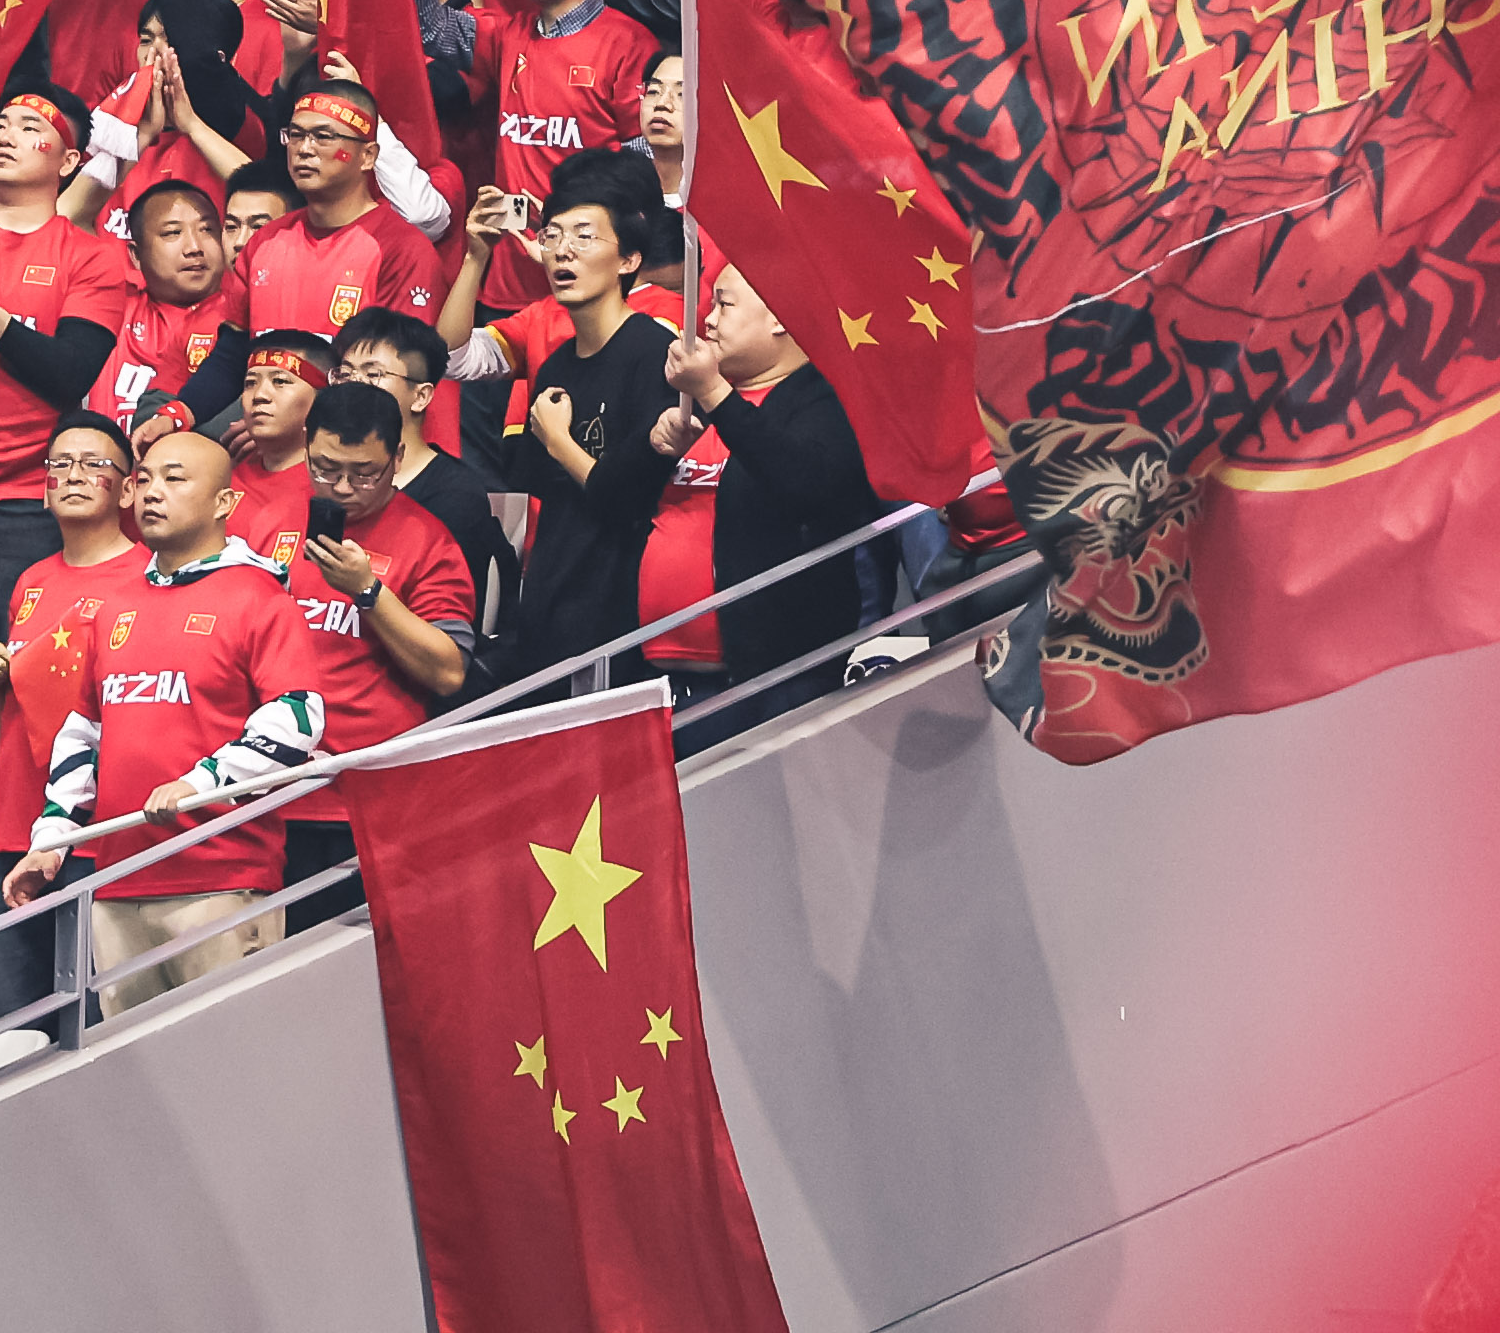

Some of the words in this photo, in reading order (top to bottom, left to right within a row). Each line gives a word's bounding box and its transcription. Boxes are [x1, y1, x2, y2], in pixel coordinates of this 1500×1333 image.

[298, 599, 362, 639] 之队
[103, 671, 190, 705] 龙之队
